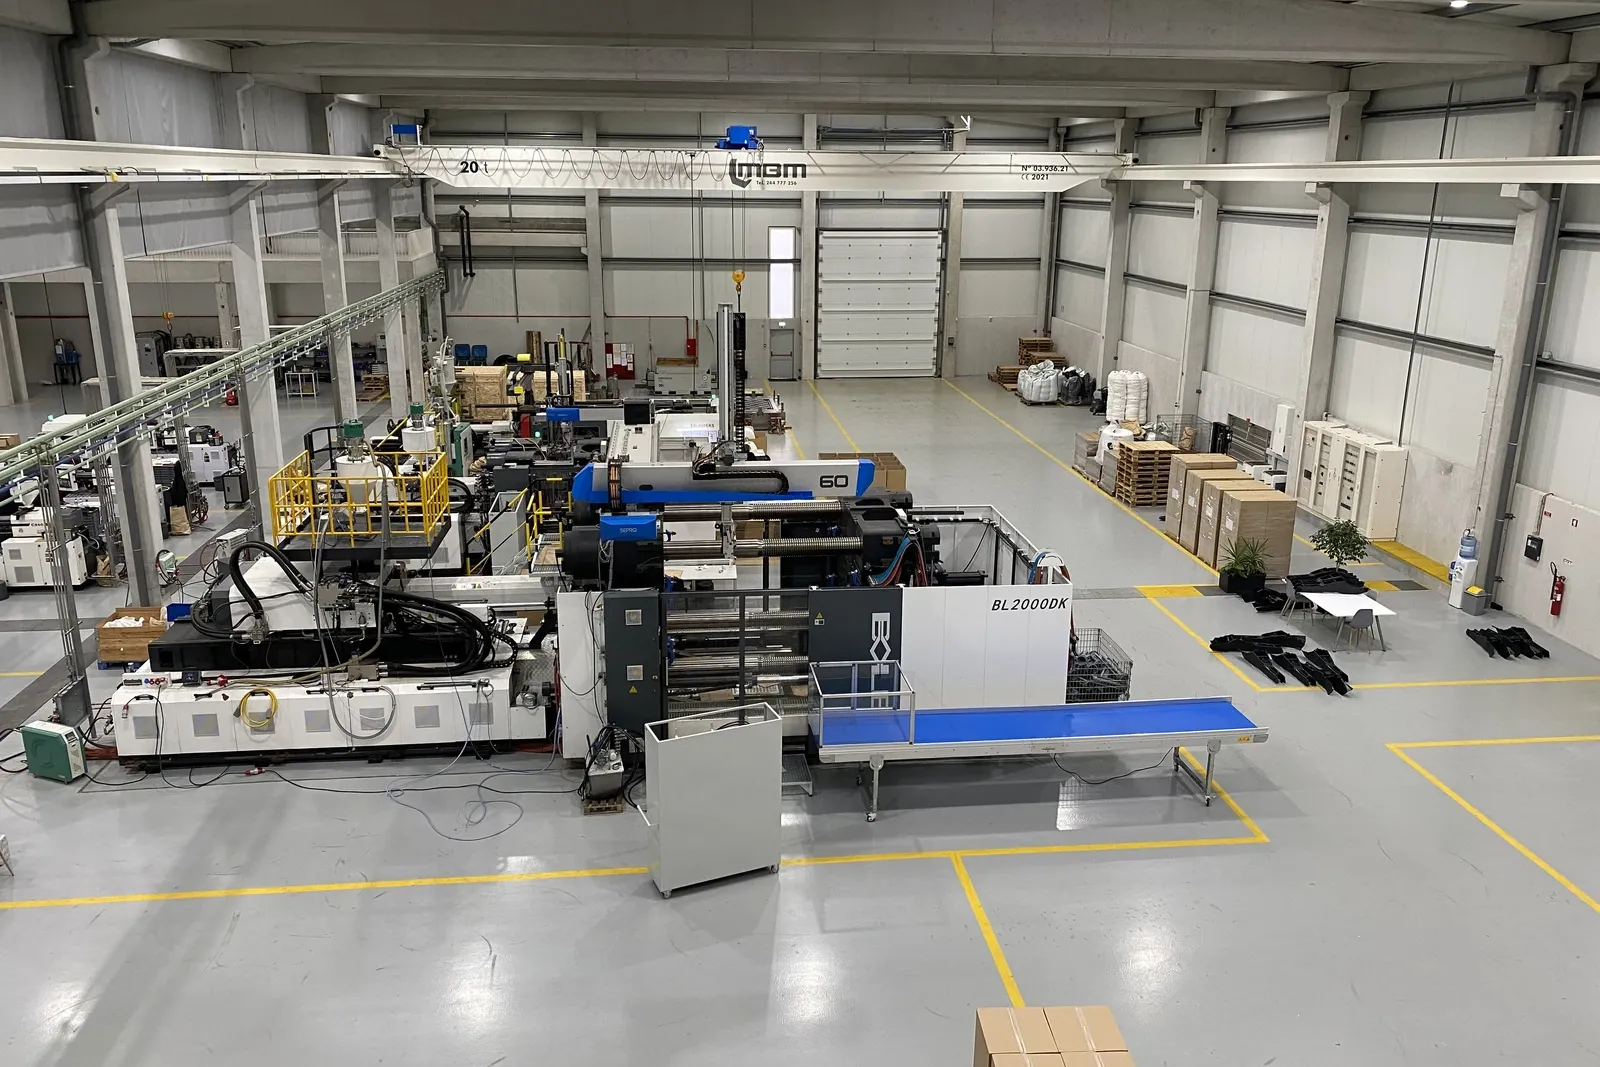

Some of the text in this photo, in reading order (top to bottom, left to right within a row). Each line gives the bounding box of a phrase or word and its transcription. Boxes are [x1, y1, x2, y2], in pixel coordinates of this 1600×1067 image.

[460, 161, 489, 174] 20 t
[737, 163, 807, 179] MBM
[819, 474, 849, 488] 60
[991, 597, 1069, 611] BL2000DK
